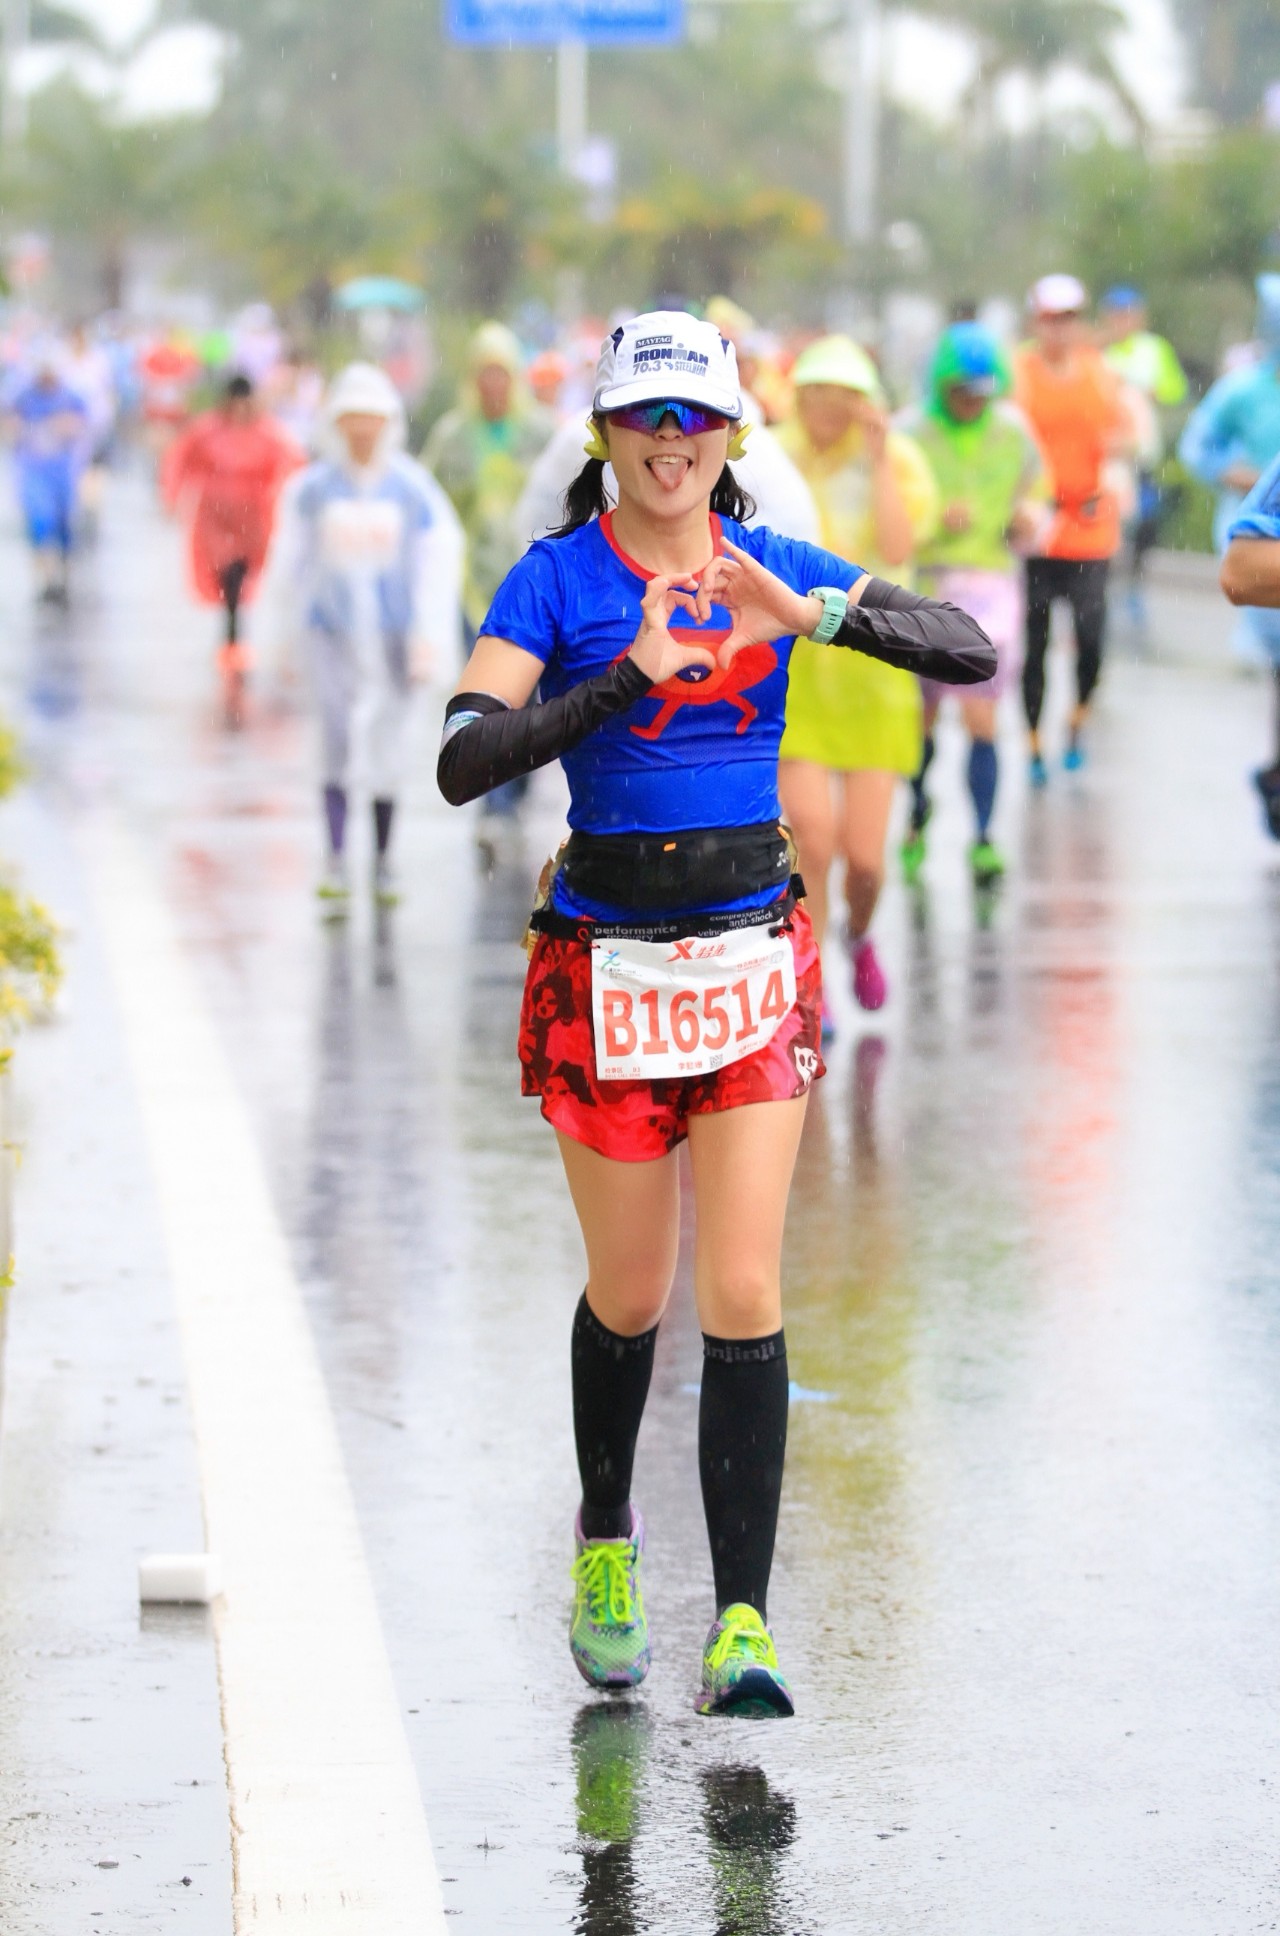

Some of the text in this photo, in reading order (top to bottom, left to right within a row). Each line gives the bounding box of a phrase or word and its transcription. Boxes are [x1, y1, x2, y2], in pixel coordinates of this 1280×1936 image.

[636, 336, 671, 348] MAYTAG
[633, 343, 709, 366] IRONMAN
[633, 360, 661, 376] 70.3
[709, 909, 765, 922] compressport
[728, 911, 774, 928] anti-shock
[594, 925, 678, 936] performance
[602, 969, 789, 1058] B16514
